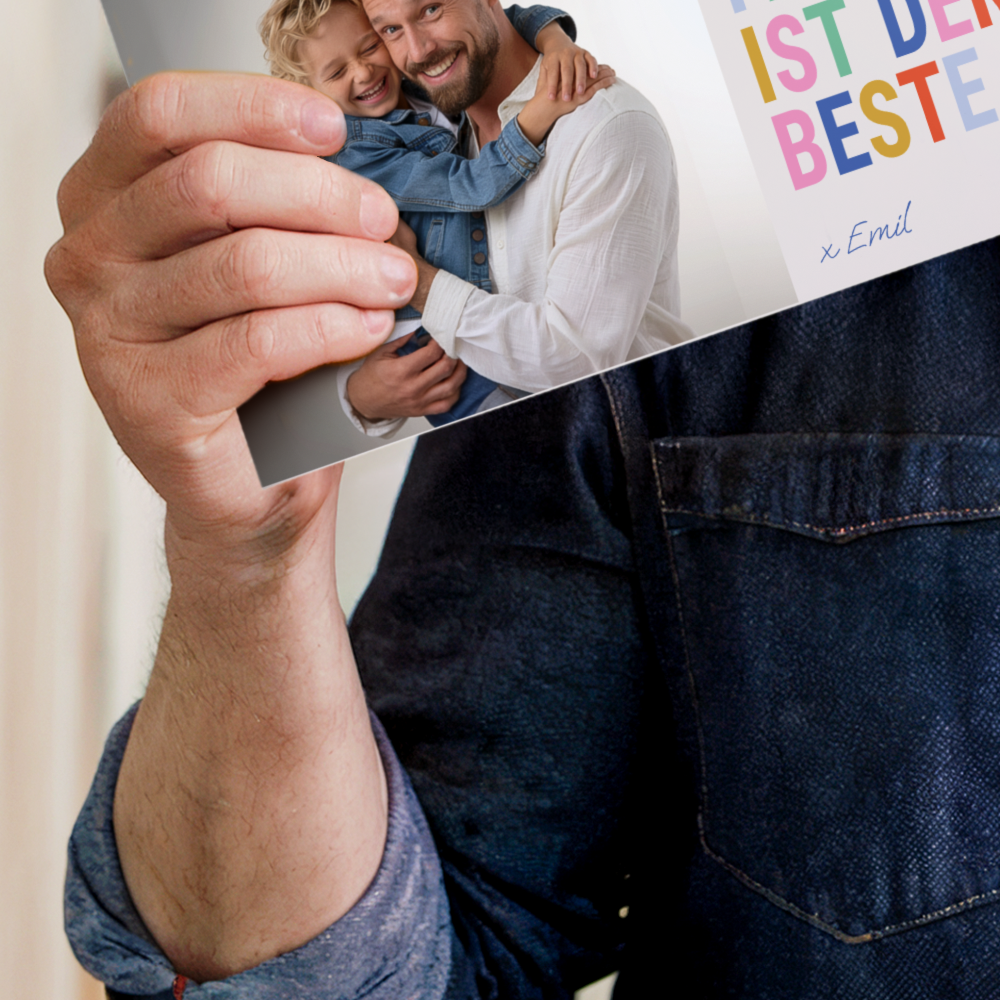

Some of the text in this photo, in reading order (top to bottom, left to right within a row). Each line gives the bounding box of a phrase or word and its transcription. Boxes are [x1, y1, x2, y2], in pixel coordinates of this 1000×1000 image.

[771, 47, 999, 191] BESTE
[820, 200, 913, 263] x Emil
